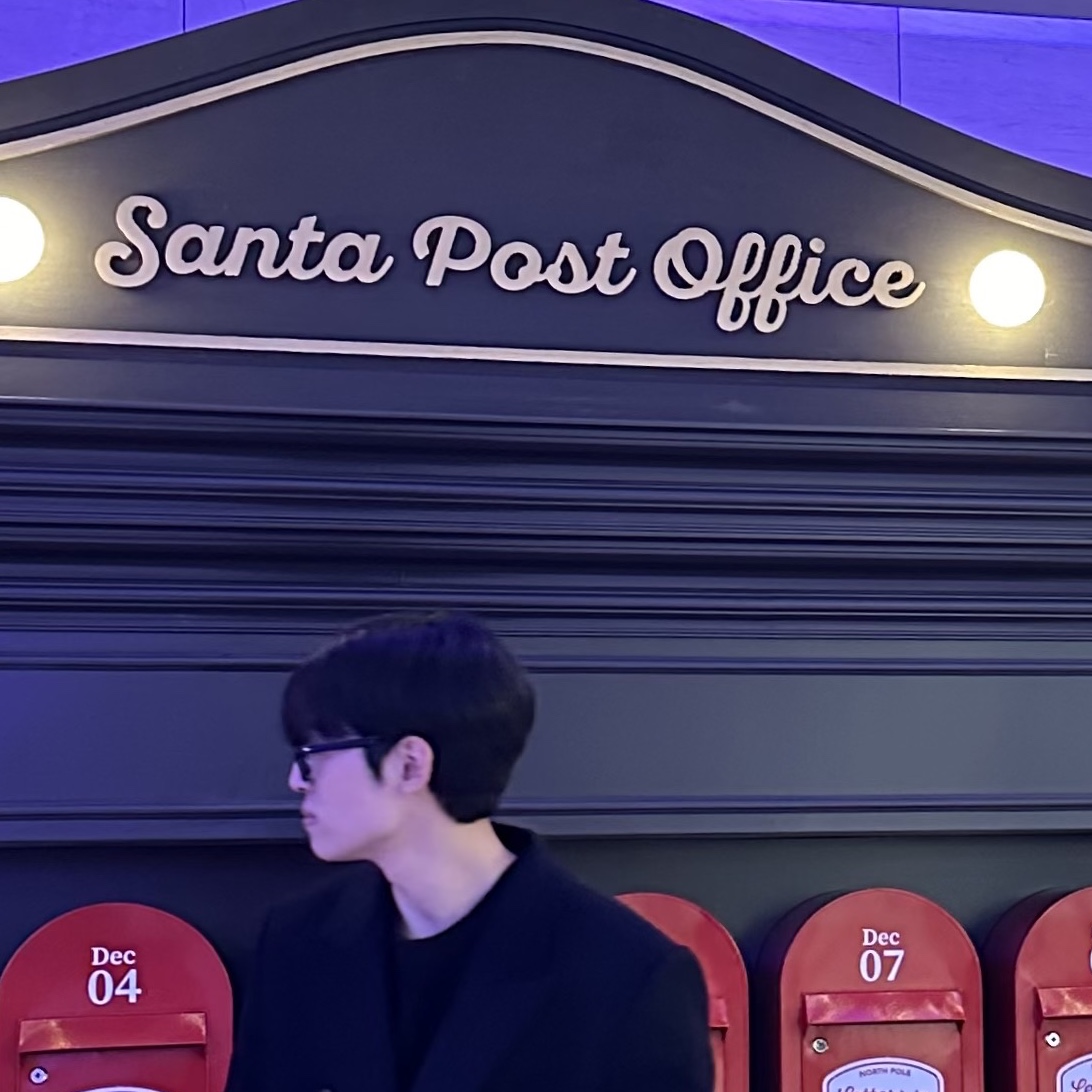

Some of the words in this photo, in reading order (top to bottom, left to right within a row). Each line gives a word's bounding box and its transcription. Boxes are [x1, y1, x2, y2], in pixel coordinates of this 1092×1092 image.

[94, 194, 393, 291] Santa
[412, 215, 636, 295] Post
[653, 226, 926, 334] Office
[862, 929, 900, 945] Dec
[91, 947, 136, 965] Dec
[860, 950, 904, 982] 07
[88, 969, 141, 1005] 04
[859, 1068, 888, 1078] NORTH
[890, 1068, 911, 1077] POLE
